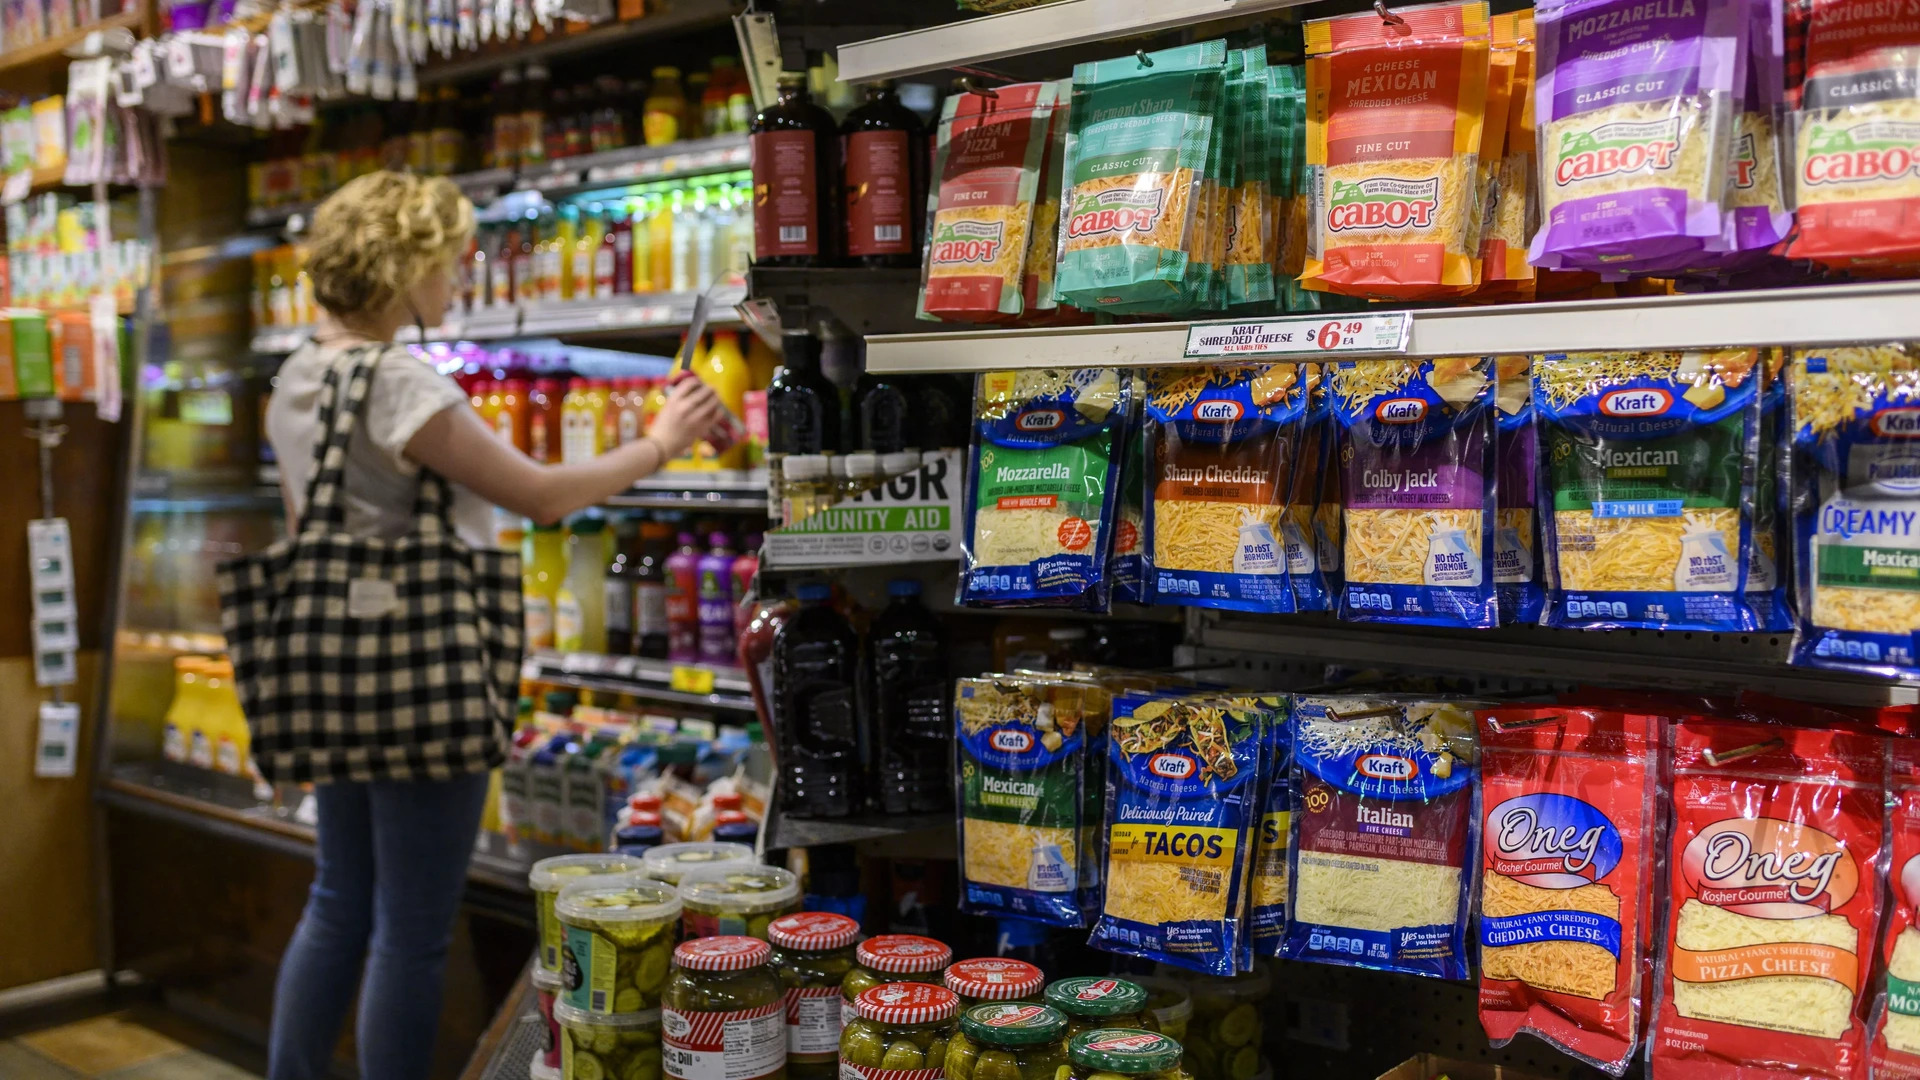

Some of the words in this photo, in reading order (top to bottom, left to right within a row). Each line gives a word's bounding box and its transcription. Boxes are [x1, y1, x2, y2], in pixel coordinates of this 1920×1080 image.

[1815, 0, 1901, 26] Seriously
[1568, 0, 1696, 43] MOZZARELLA
[1580, 47, 1628, 61] SHREDDED
[1364, 64, 1371, 73] 4
[1374, 60, 1420, 72] CHEESE
[1346, 71, 1437, 98] MEXICAN
[1829, 80, 1893, 97] CLASSIC
[1348, 98, 1391, 108] SHREDDED
[1394, 92, 1428, 106] CHEESE
[1576, 84, 1631, 104] CLASSIC
[1635, 81, 1664, 92] CUT
[1092, 103, 1137, 123] Vermont
[1138, 98, 1174, 114] Sharp
[960, 122, 1012, 142] ARTISAN
[1087, 123, 1118, 136] SHREDDED
[1119, 118, 1150, 129] CHEDDAR
[1151, 114, 1178, 124] CHEESE
[964, 137, 997, 153] PIZZA
[1355, 143, 1382, 154] FINE
[1386, 141, 1411, 151] CUT
[1090, 160, 1130, 172] CLASSIC
[1132, 157, 1153, 166] CUT
[1557, 141, 1675, 183] CABOT
[1390, 182, 1424, 190] Co-operative
[953, 191, 970, 201] FINE
[971, 190, 988, 199] CUT
[1069, 208, 1157, 235] CABOT
[1330, 201, 1434, 229] CABOT
[1231, 325, 1264, 335] KRAFT
[1306, 329, 1316, 342] $
[1317, 321, 1342, 350] 6
[1343, 322, 1362, 334] 49
[1199, 335, 1254, 346] SHREDDED
[1255, 333, 1294, 343] CHEESE
[1236, 343, 1268, 351] VARIETIES
[1342, 337, 1354, 345] EA
[1614, 395, 1656, 411] Kraft
[1202, 404, 1231, 418] Kraft
[1386, 404, 1418, 419] Kraft
[1025, 414, 1054, 427] Kraft
[1590, 419, 1634, 433] Natural
[1638, 419, 1681, 432] Cheese
[1886, 413, 1920, 430] Kraf
[1006, 433, 1036, 443] Natural
[1184, 424, 1215, 437] Natural
[1596, 447, 1679, 467] Mexican
[996, 463, 1070, 483] Mozzarella
[1164, 463, 1203, 486] Sharp
[1205, 465, 1268, 484] Cheddar
[1634, 468, 1660, 476] CHEESE
[1363, 470, 1402, 492] Colby
[1404, 469, 1437, 492] Jack
[1182, 487, 1203, 497] SHREDDED
[1204, 488, 1223, 497] CHEDDAR
[1224, 488, 1240, 497] CHEESE
[1429, 494, 1450, 503] CHEESES
[1019, 498, 1038, 506] WHOLE
[1038, 497, 1051, 506] MILK
[1613, 504, 1625, 515] 2%
[1627, 503, 1655, 515] MILK
[782, 508, 889, 532] MUNITY
[904, 508, 941, 529] AID
[1823, 504, 1916, 539] CREAMY
[1244, 545, 1254, 553] NO
[1255, 544, 1270, 552] rbST
[1244, 552, 1274, 561] HORMONE
[1435, 553, 1445, 562] NO
[1446, 552, 1464, 562] rbST
[1689, 557, 1701, 566] NO
[1703, 555, 1722, 565] rbST
[1863, 550, 1920, 567] Mexica
[1037, 562, 1050, 577] Yes
[1434, 562, 1468, 571] HORMONE
[1689, 565, 1726, 576] HORMONE
[998, 734, 1024, 748] Kraft
[1158, 758, 1185, 774] Kraft
[1369, 760, 1404, 775] Kraft
[983, 776, 1035, 796] Mexican
[1139, 775, 1167, 791] Natural
[1170, 783, 1197, 793] Cheese
[1389, 782, 1425, 794] Cheese
[1305, 791, 1329, 808] 100
[1120, 803, 1176, 827] Deliciously
[1176, 806, 1214, 822] Paired
[1356, 804, 1414, 828] Italian
[1366, 825, 1379, 833] FIVE
[1381, 827, 1403, 836] CHEESE
[1144, 831, 1224, 859] TACOS
[1319, 829, 1345, 840] SHREDDED
[1345, 831, 1385, 843] LOW-MOISTURE
[1385, 836, 1413, 848] PART-SKIM
[1498, 807, 1606, 875] Oneg
[1317, 838, 1347, 851] PROVOLONE,
[1348, 841, 1377, 854] PARMESAN,
[1378, 845, 1399, 857] ASIAGO,
[1404, 848, 1426, 858] ROMANO
[1427, 850, 1448, 860] CHEESES
[1496, 861, 1524, 872] Kosher
[1524, 861, 1562, 872] Gourmet
[1703, 830, 1843, 903] Oneg
[1199, 884, 1219, 894] SEASONING
[1701, 890, 1737, 901] Kosher
[1491, 919, 1522, 929] NATURAL
[1527, 914, 1553, 924] FANCY
[1554, 914, 1599, 926] SHREDDED
[1167, 926, 1180, 940] Yes
[1401, 932, 1417, 946] Yes
[1488, 925, 1544, 943] CHEDDAR
[1549, 923, 1600, 940] CHEESE
[1695, 953, 1739, 964] NATURAL
[1746, 948, 1779, 959] FANCY
[1779, 947, 1836, 959] SHREDDED
[1700, 963, 1754, 980] PIZZA
[1762, 958, 1831, 975] CHEESE
[1603, 1009, 1611, 1022] 2
[1690, 1010, 1711, 1018] Freshness
[1757, 1020, 1776, 1029] packages
[1664, 1026, 1674, 1034] KEEP
[1674, 1028, 1709, 1040] REFRIGERATED
[1672, 1040, 1681, 1048] OZ
[1682, 1041, 1705, 1051] (226g)
[678, 1051, 692, 1066] Dill
[1839, 1049, 1849, 1063] 2
